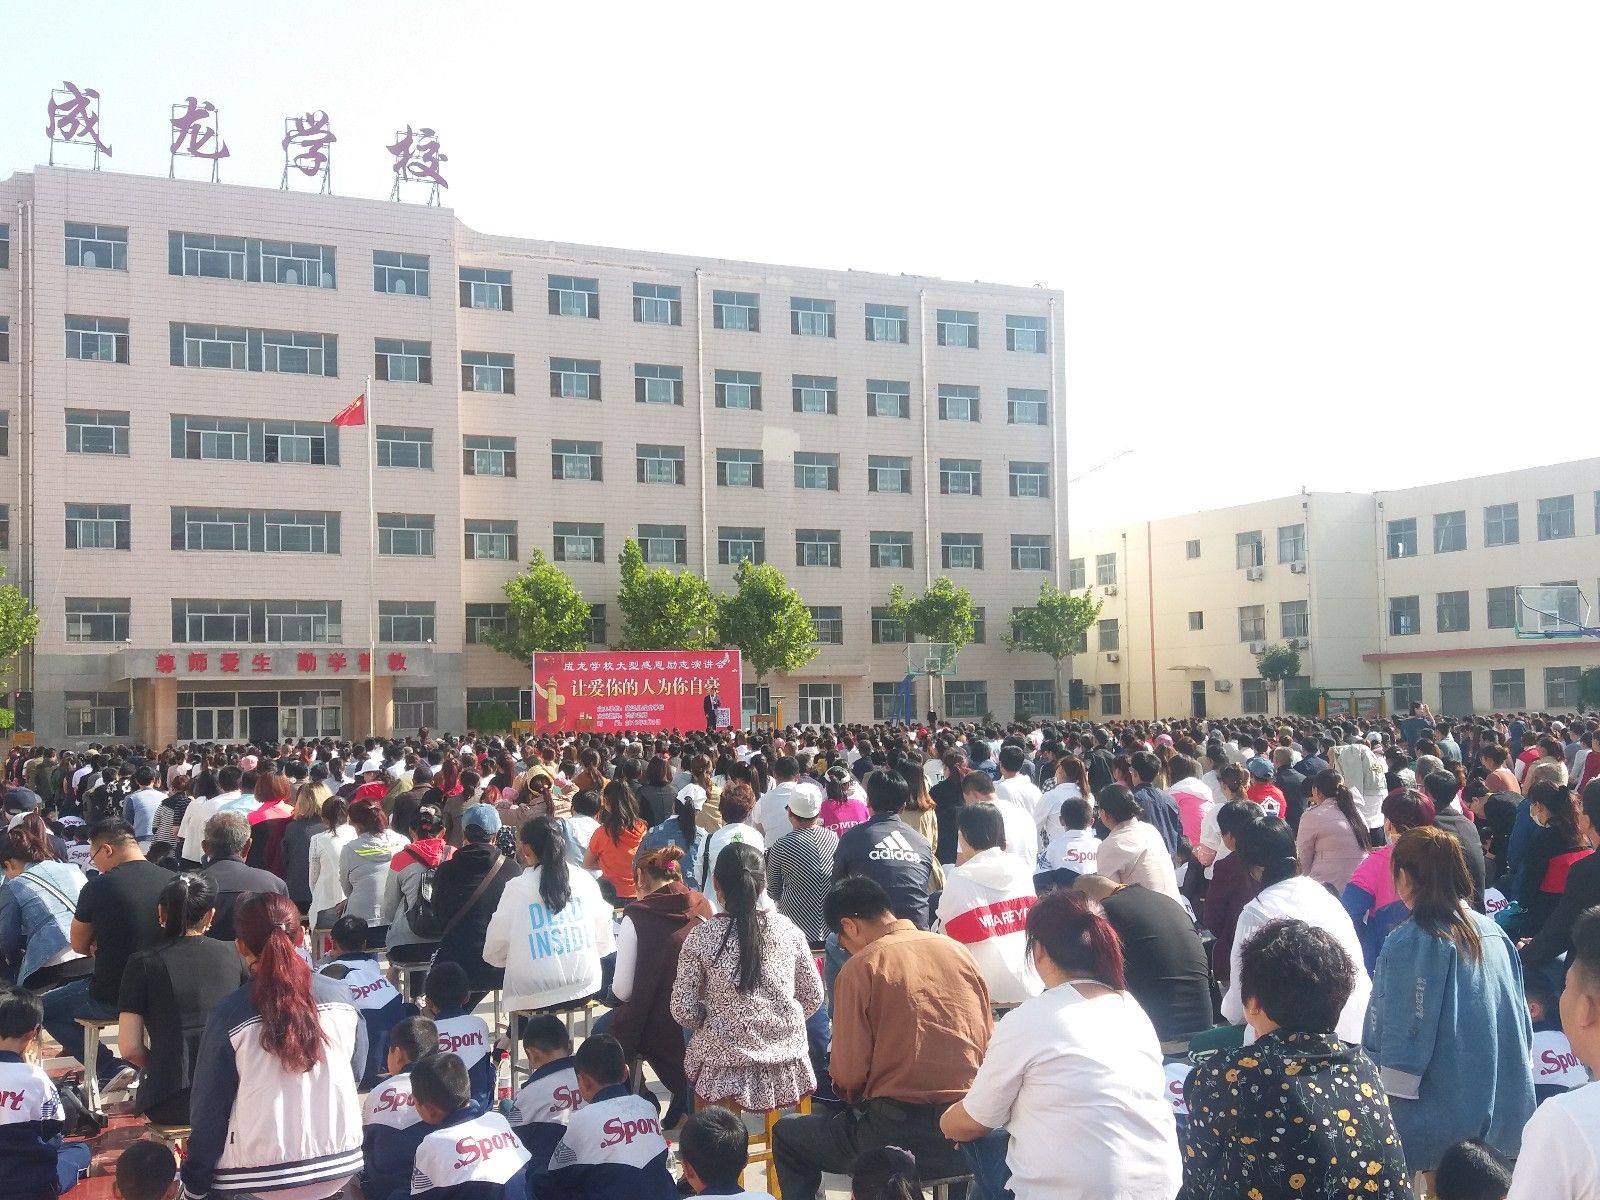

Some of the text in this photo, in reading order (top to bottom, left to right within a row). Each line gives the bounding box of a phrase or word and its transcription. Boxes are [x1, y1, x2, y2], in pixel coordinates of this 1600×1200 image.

[46, 81, 449, 190] 成龙学校
[563, 659, 727, 672] 成龙学校大型感恩励志演讲会
[571, 677, 720, 697] 让爱你的人为你自豪
[69, 850, 90, 861] Spor
[869, 848, 920, 864] adidas
[438, 1030, 483, 1052] Sport
[374, 1087, 416, 1114] Spo
[549, 1085, 582, 1112] Sp
[600, 1116, 662, 1149] Sport
[453, 1130, 520, 1170] Sport
